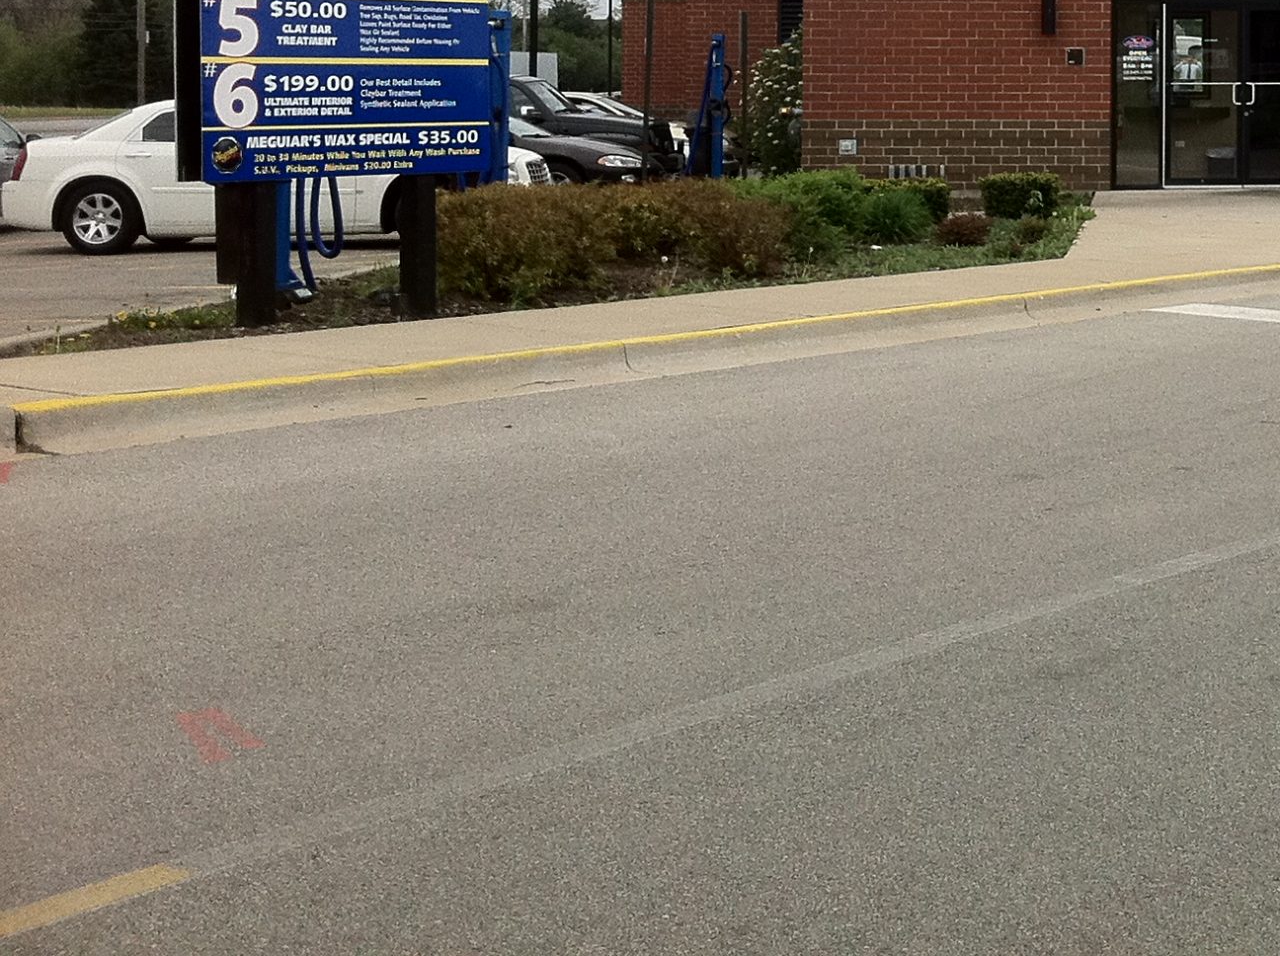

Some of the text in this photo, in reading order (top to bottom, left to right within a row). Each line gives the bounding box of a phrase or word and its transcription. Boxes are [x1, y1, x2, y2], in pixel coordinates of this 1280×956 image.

[270, 0, 347, 19] $50.00
[282, 24, 332, 34] CLAY BAR
[276, 36, 338, 46] TREATMENT
[264, 74, 354, 93] $199.00
[204, 62, 259, 129] #6
[360, 90, 386, 98] Claybar
[264, 97, 352, 106] ULTIMATE INTERIOR
[360, 100, 391, 108] Synthetic
[420, 100, 456, 108] Application
[264, 107, 352, 117] & EXTERIOR DETAIL
[246, 130, 478, 149] MEGUIAR'S WAX SPECIAL $35.00
[292, 152, 324, 161] Minutes
[327, 150, 349, 159] While
[351, 151, 366, 159] You
[368, 149, 386, 158] Wait
[388, 149, 407, 158] With
[409, 148, 424, 158] Any
[425, 147, 446, 156] Wash
[447, 147, 480, 155] Purchase
[324, 163, 359, 172] Minivans
[363, 161, 392, 170] $20.00
[393, 161, 413, 169] Extra
